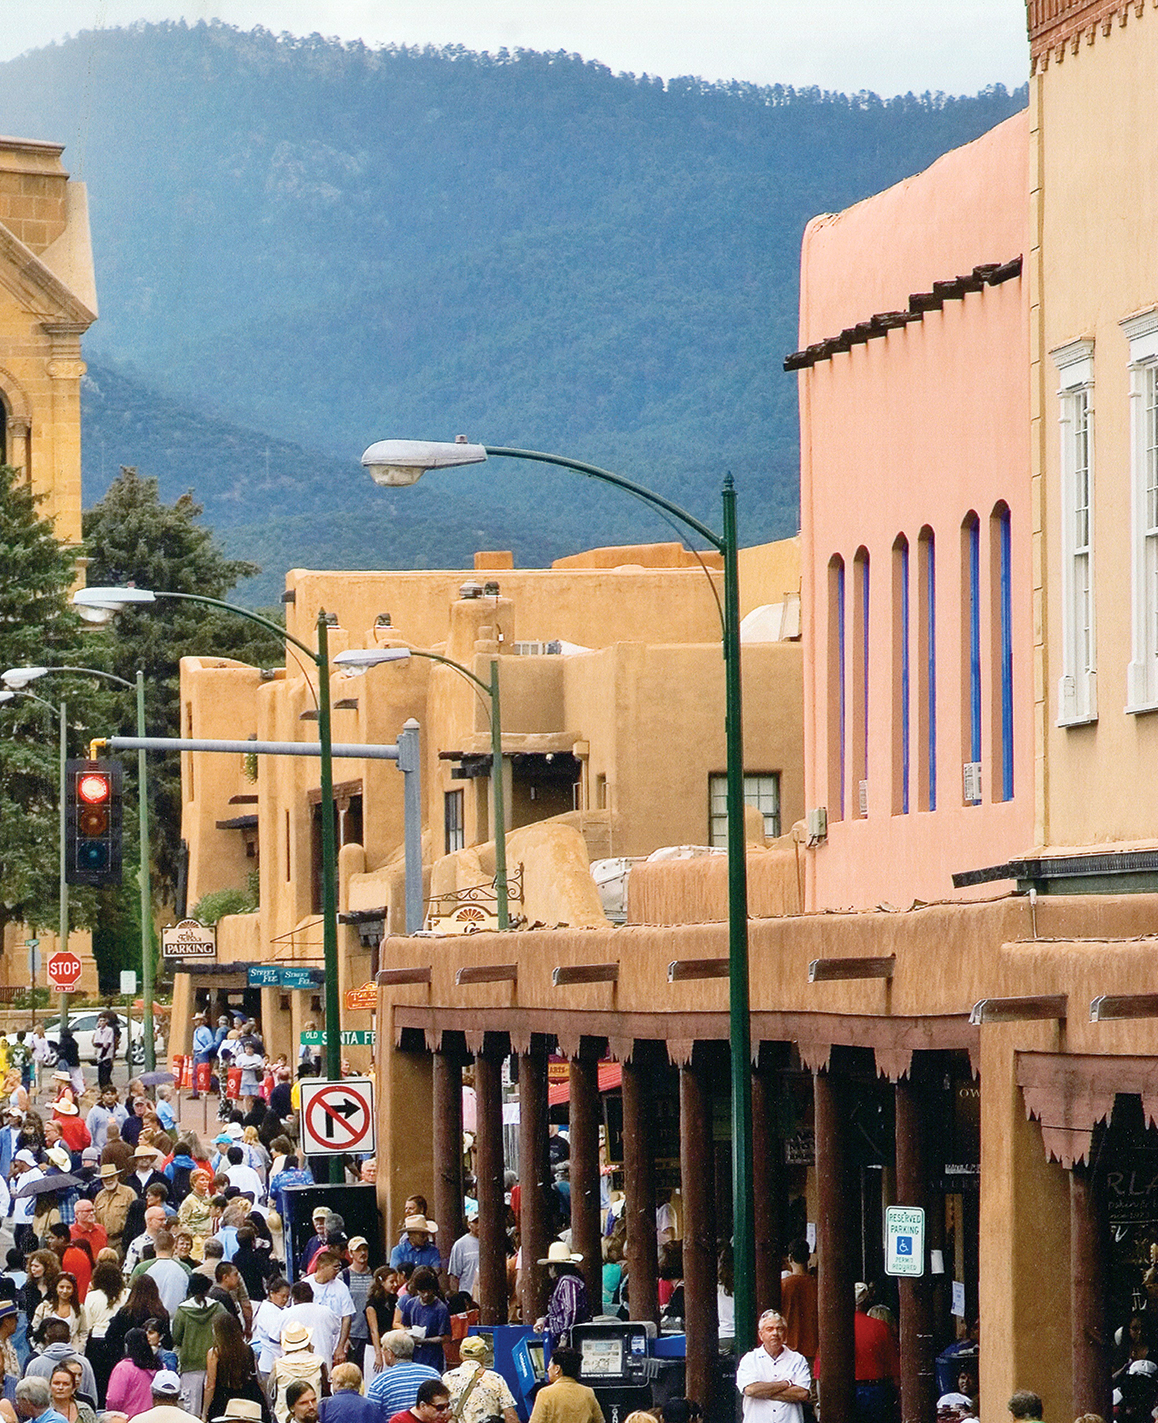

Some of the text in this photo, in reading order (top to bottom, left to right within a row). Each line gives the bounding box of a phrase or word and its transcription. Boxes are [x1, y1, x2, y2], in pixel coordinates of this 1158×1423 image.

[167, 943, 213, 954] PARKING
[50, 961, 80, 975] STOP
[305, 1032, 318, 1040] OLD
[889, 1213, 922, 1224] RESERVED
[890, 1224, 920, 1235] PARKING
